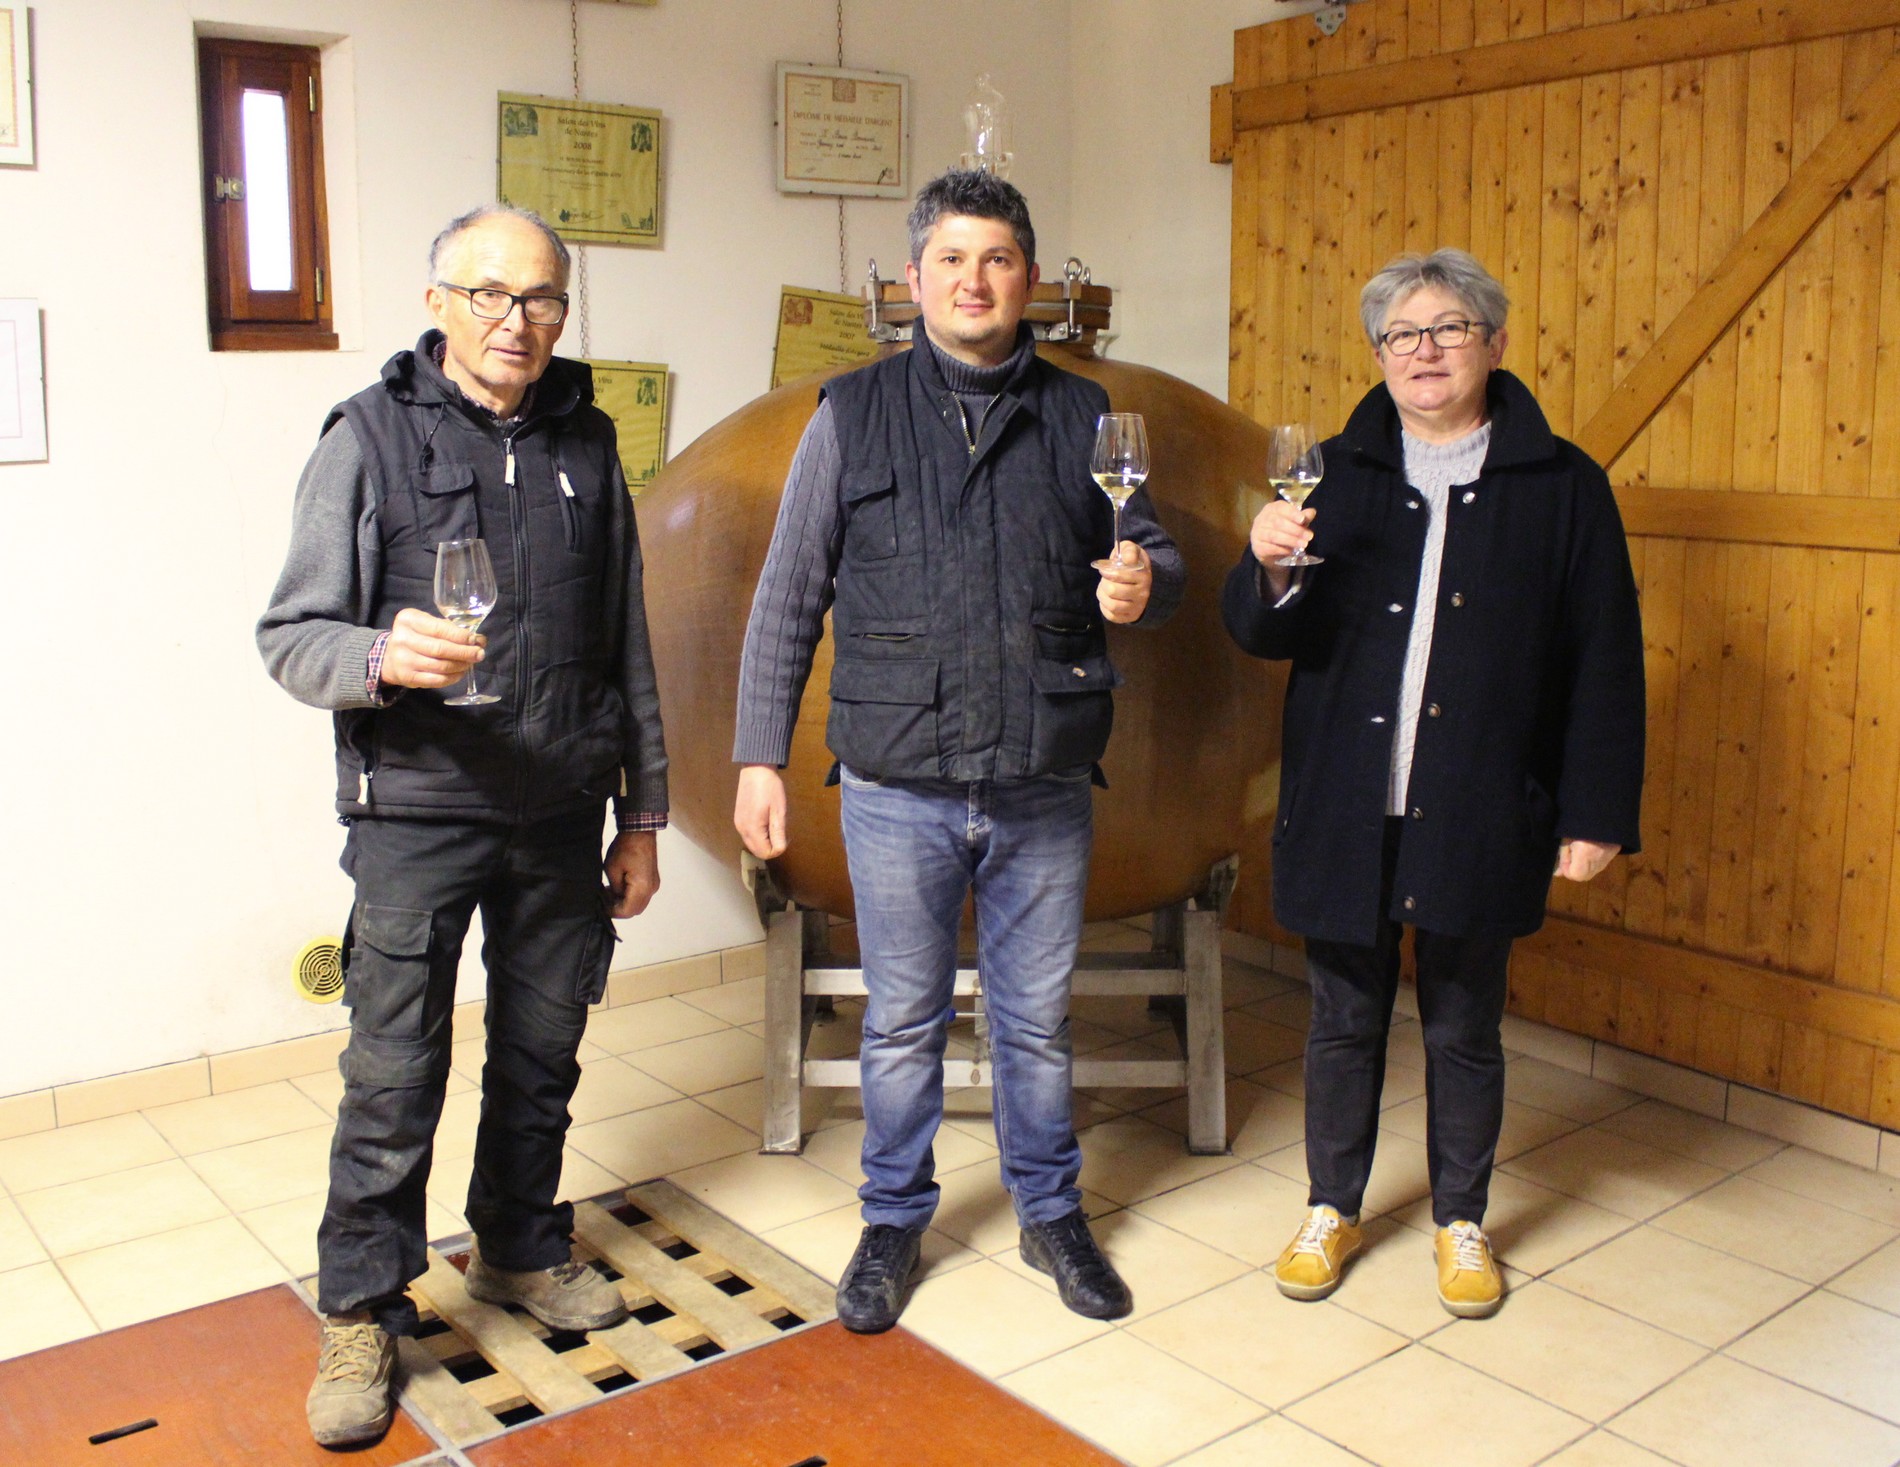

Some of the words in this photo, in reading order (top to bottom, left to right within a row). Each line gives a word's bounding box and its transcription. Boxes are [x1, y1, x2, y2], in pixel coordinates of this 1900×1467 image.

[823, 113, 831, 121] DE
[558, 118, 576, 126] Salon
[591, 119, 606, 129] Vins
[574, 142, 592, 150] 2008
